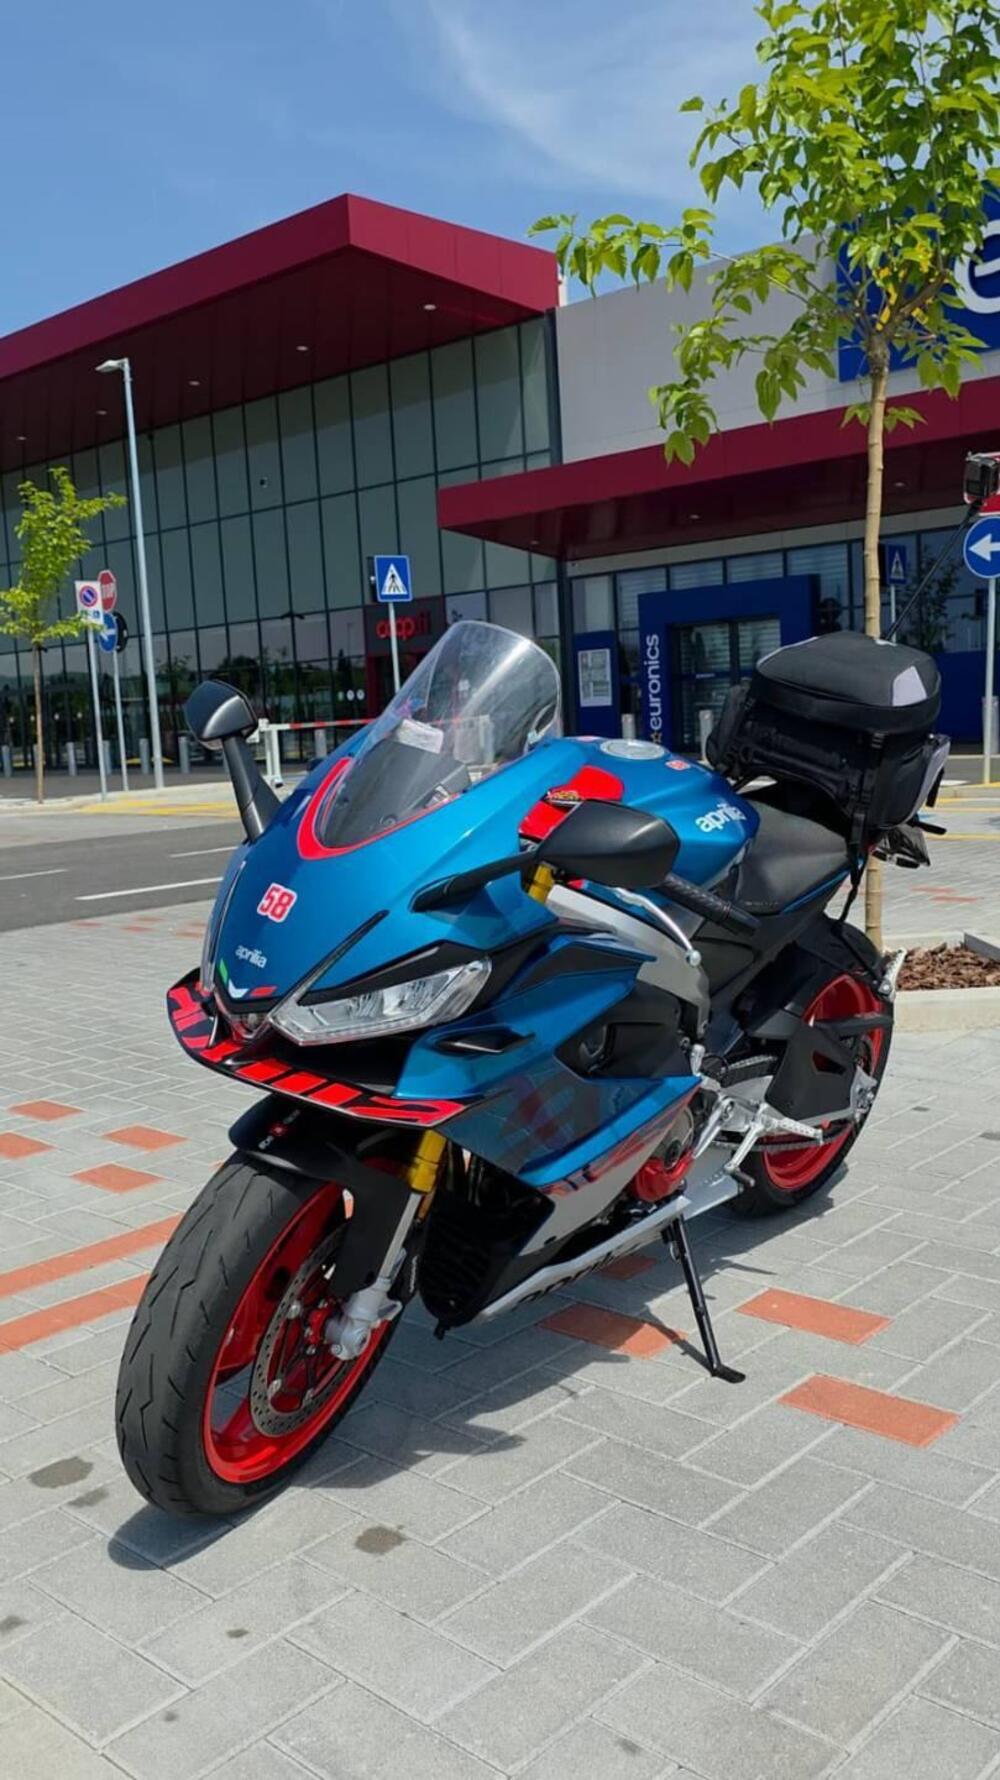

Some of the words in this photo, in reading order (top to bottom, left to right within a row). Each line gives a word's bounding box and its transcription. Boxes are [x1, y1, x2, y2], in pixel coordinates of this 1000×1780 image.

[643, 633, 662, 731] euronics
[258, 884, 297, 922] 58
[235, 945, 267, 968] aprilia
